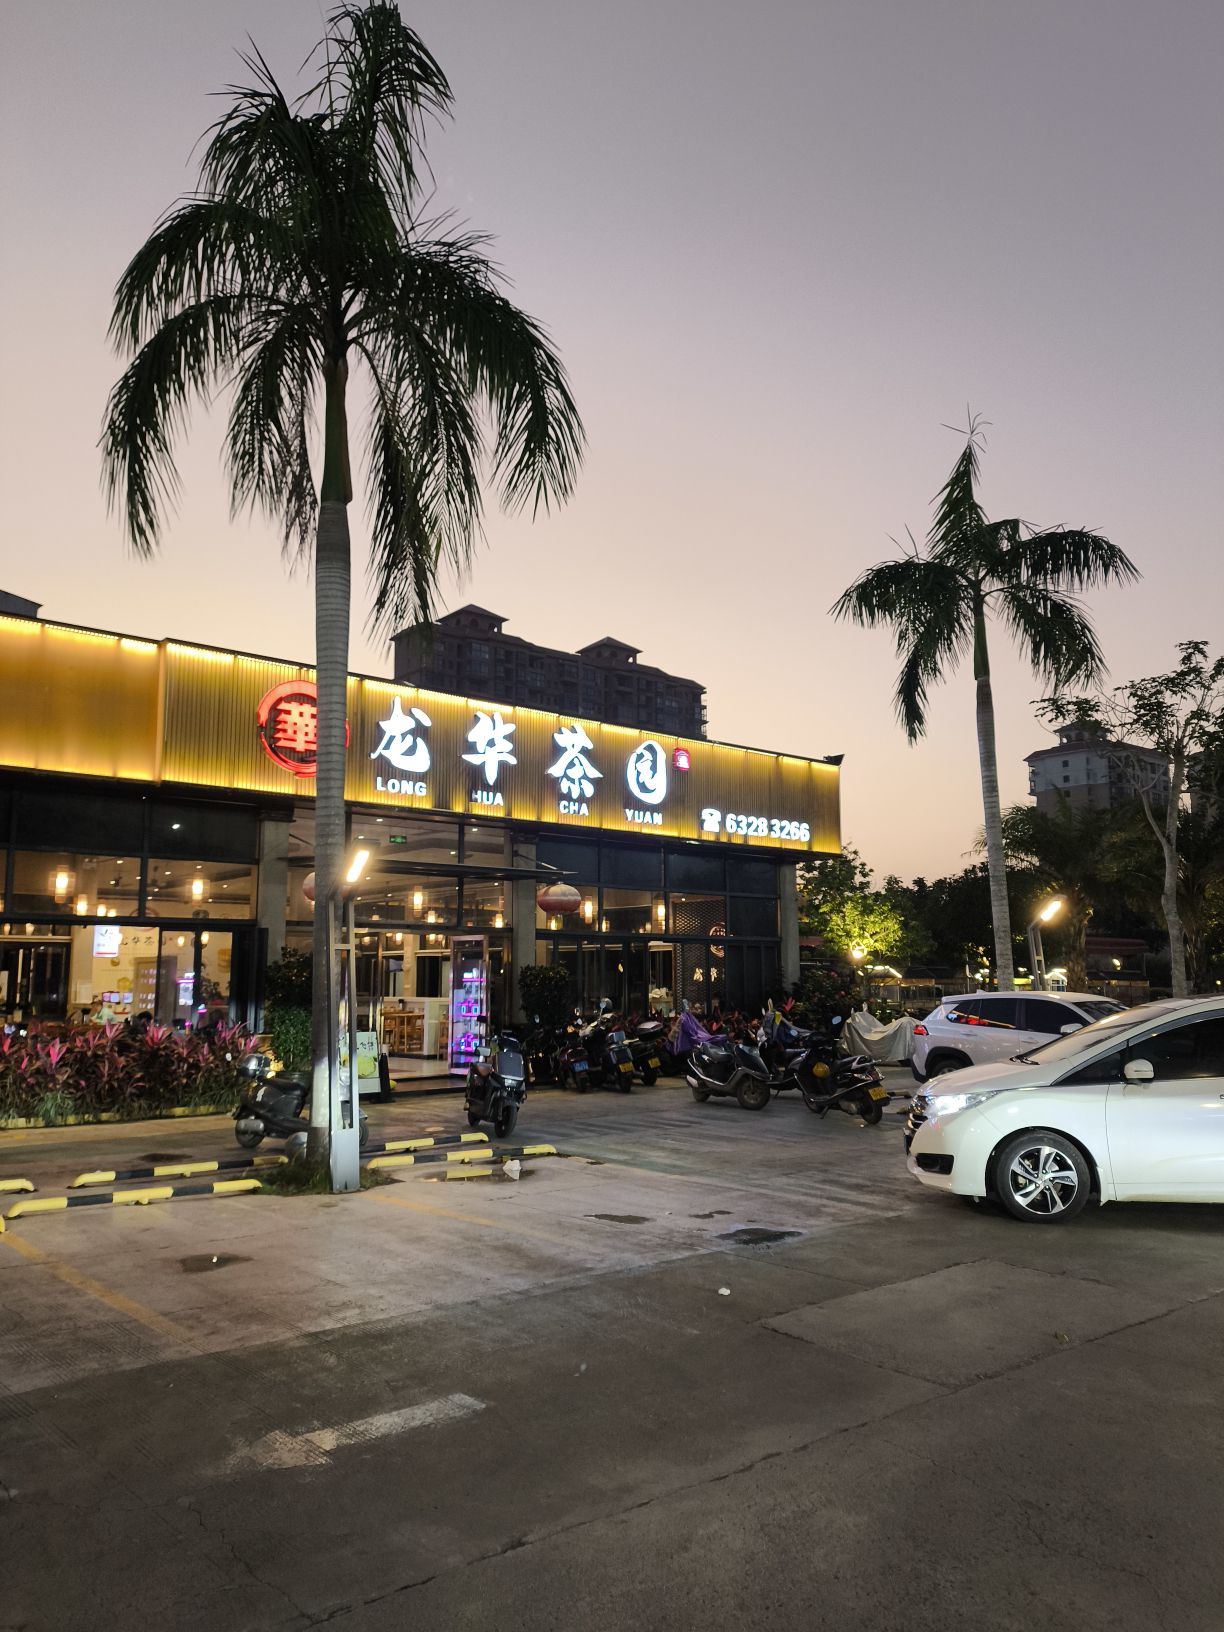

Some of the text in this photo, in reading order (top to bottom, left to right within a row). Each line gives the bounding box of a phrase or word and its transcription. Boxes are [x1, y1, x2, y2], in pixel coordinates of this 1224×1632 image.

[273, 701, 317, 752] 華
[369, 696, 667, 805] 龙华茶园
[376, 776, 663, 826] LONG HUA CHA YUAN
